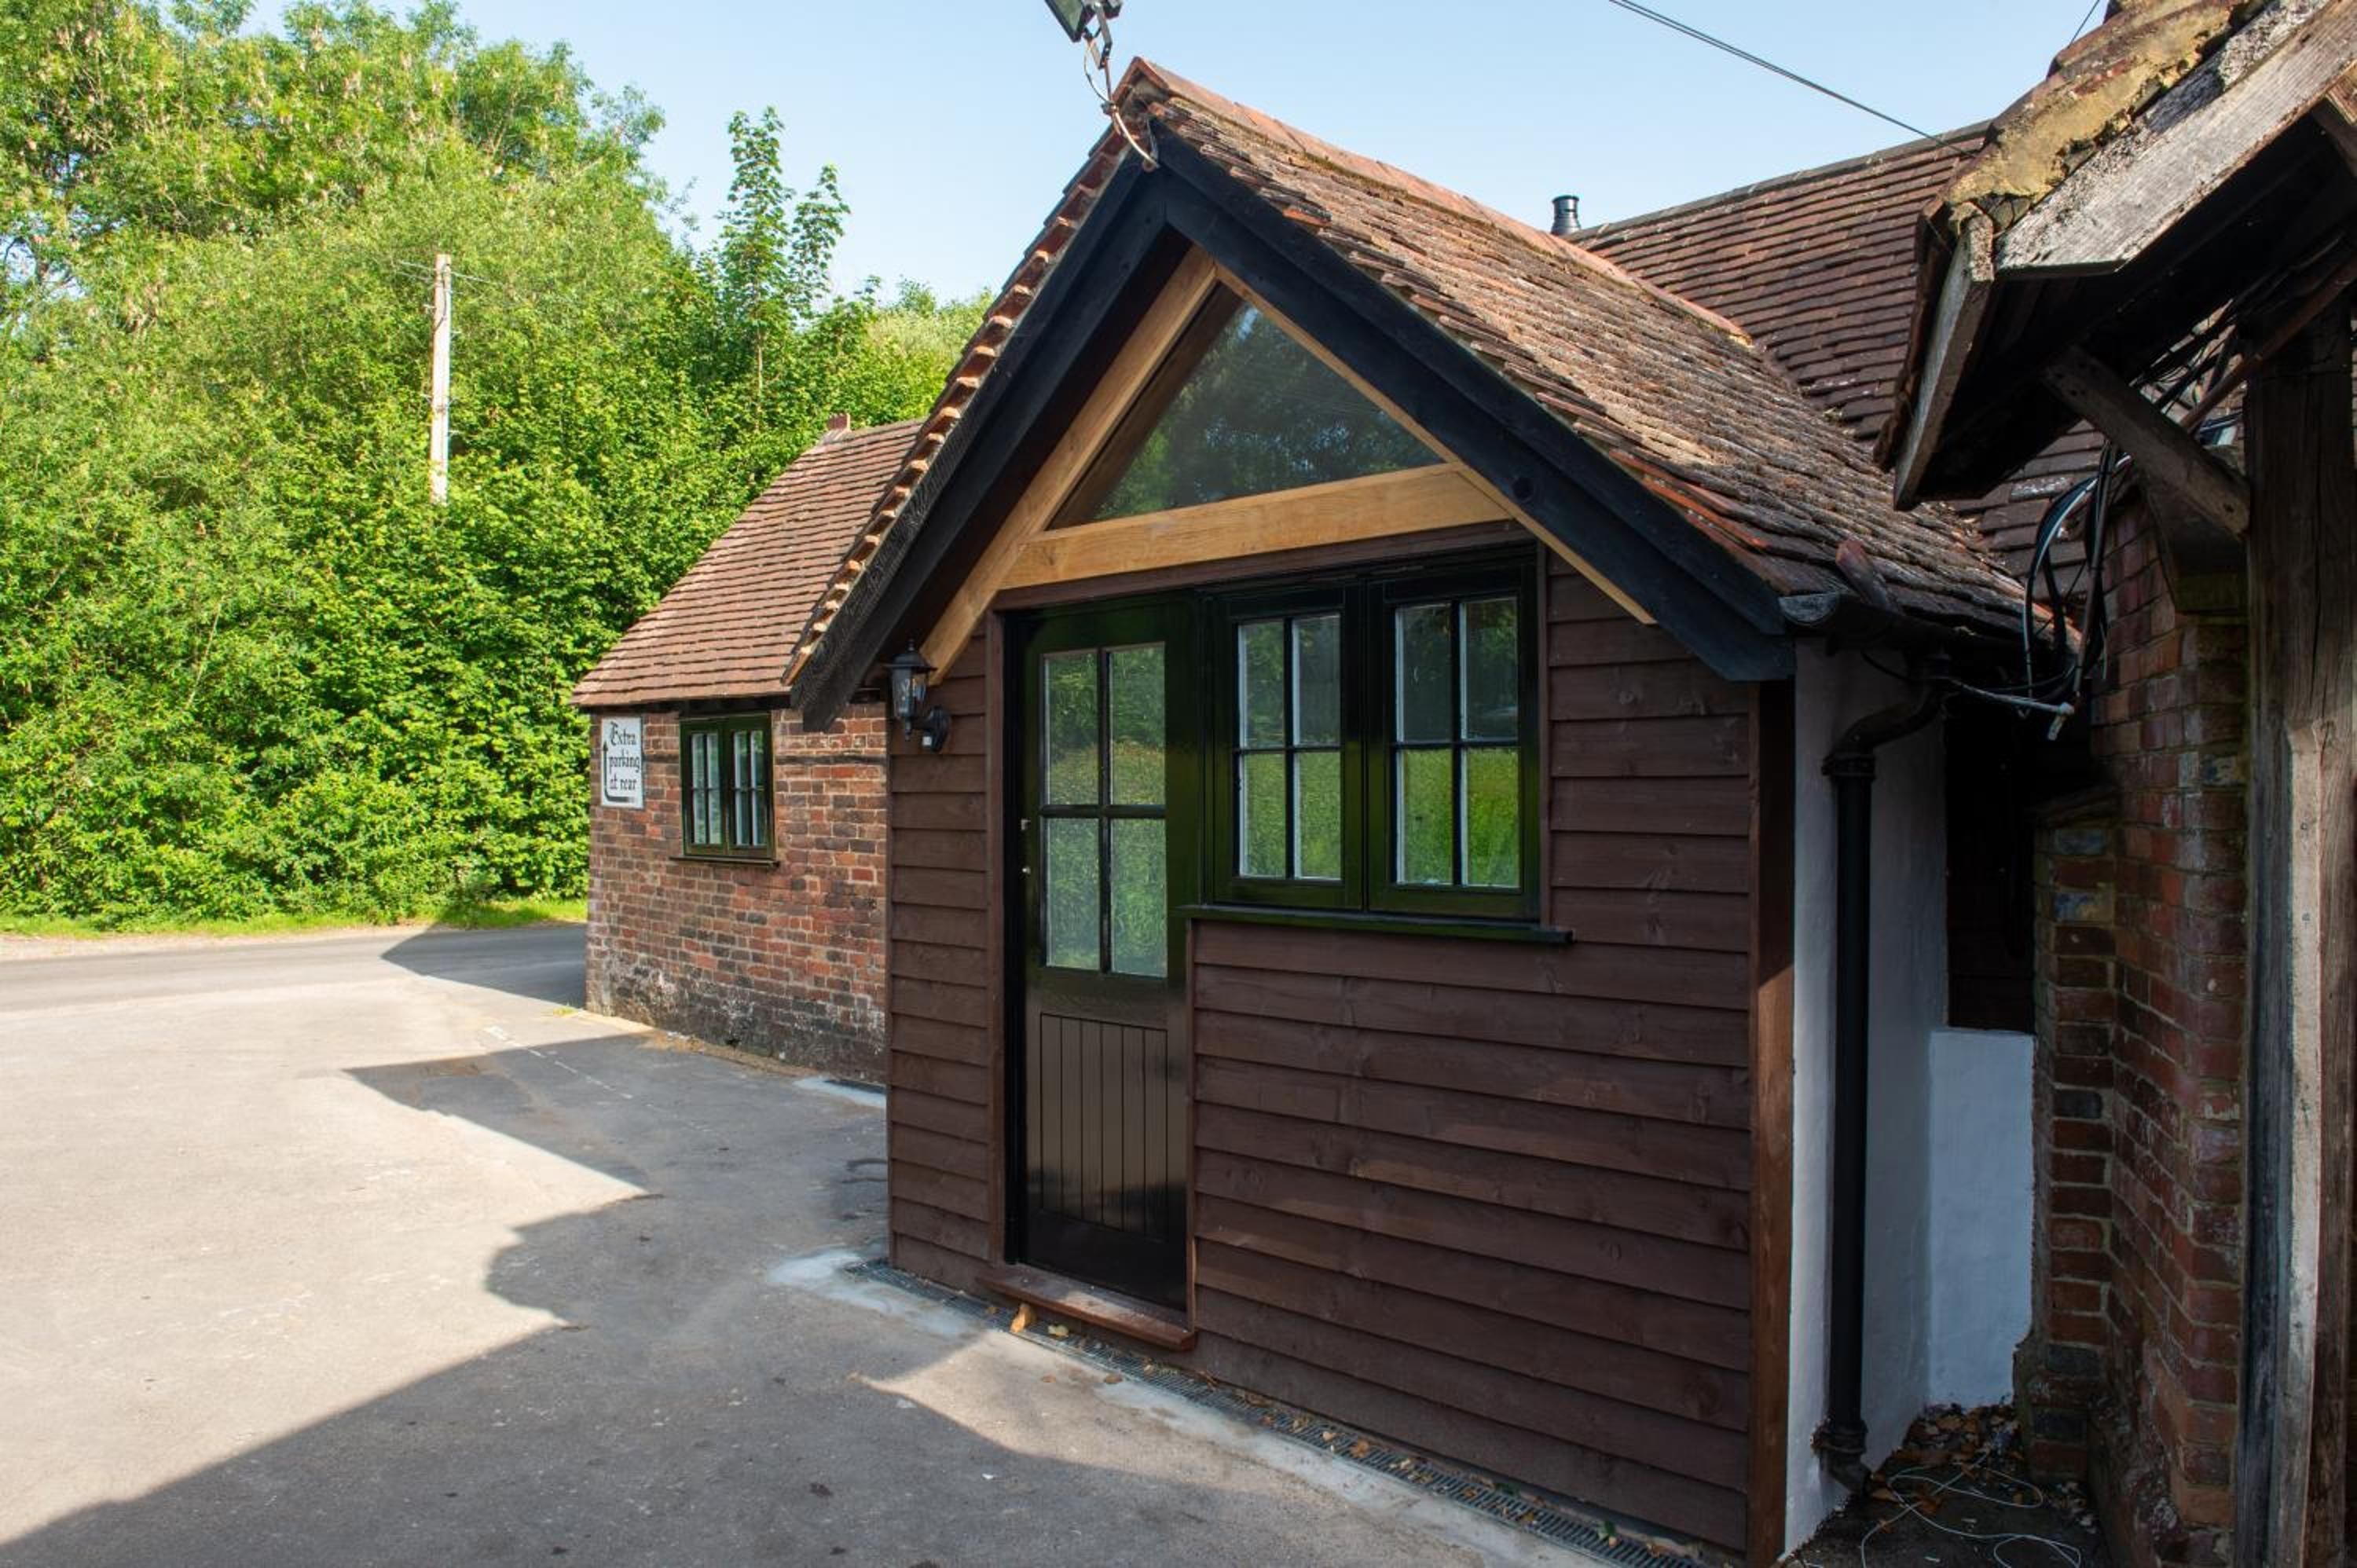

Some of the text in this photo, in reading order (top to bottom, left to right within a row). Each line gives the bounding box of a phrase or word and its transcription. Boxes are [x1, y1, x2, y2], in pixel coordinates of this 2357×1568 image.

[610, 721, 637, 746] Extra
[609, 749, 640, 773] parking
[609, 774, 637, 790] at rear
